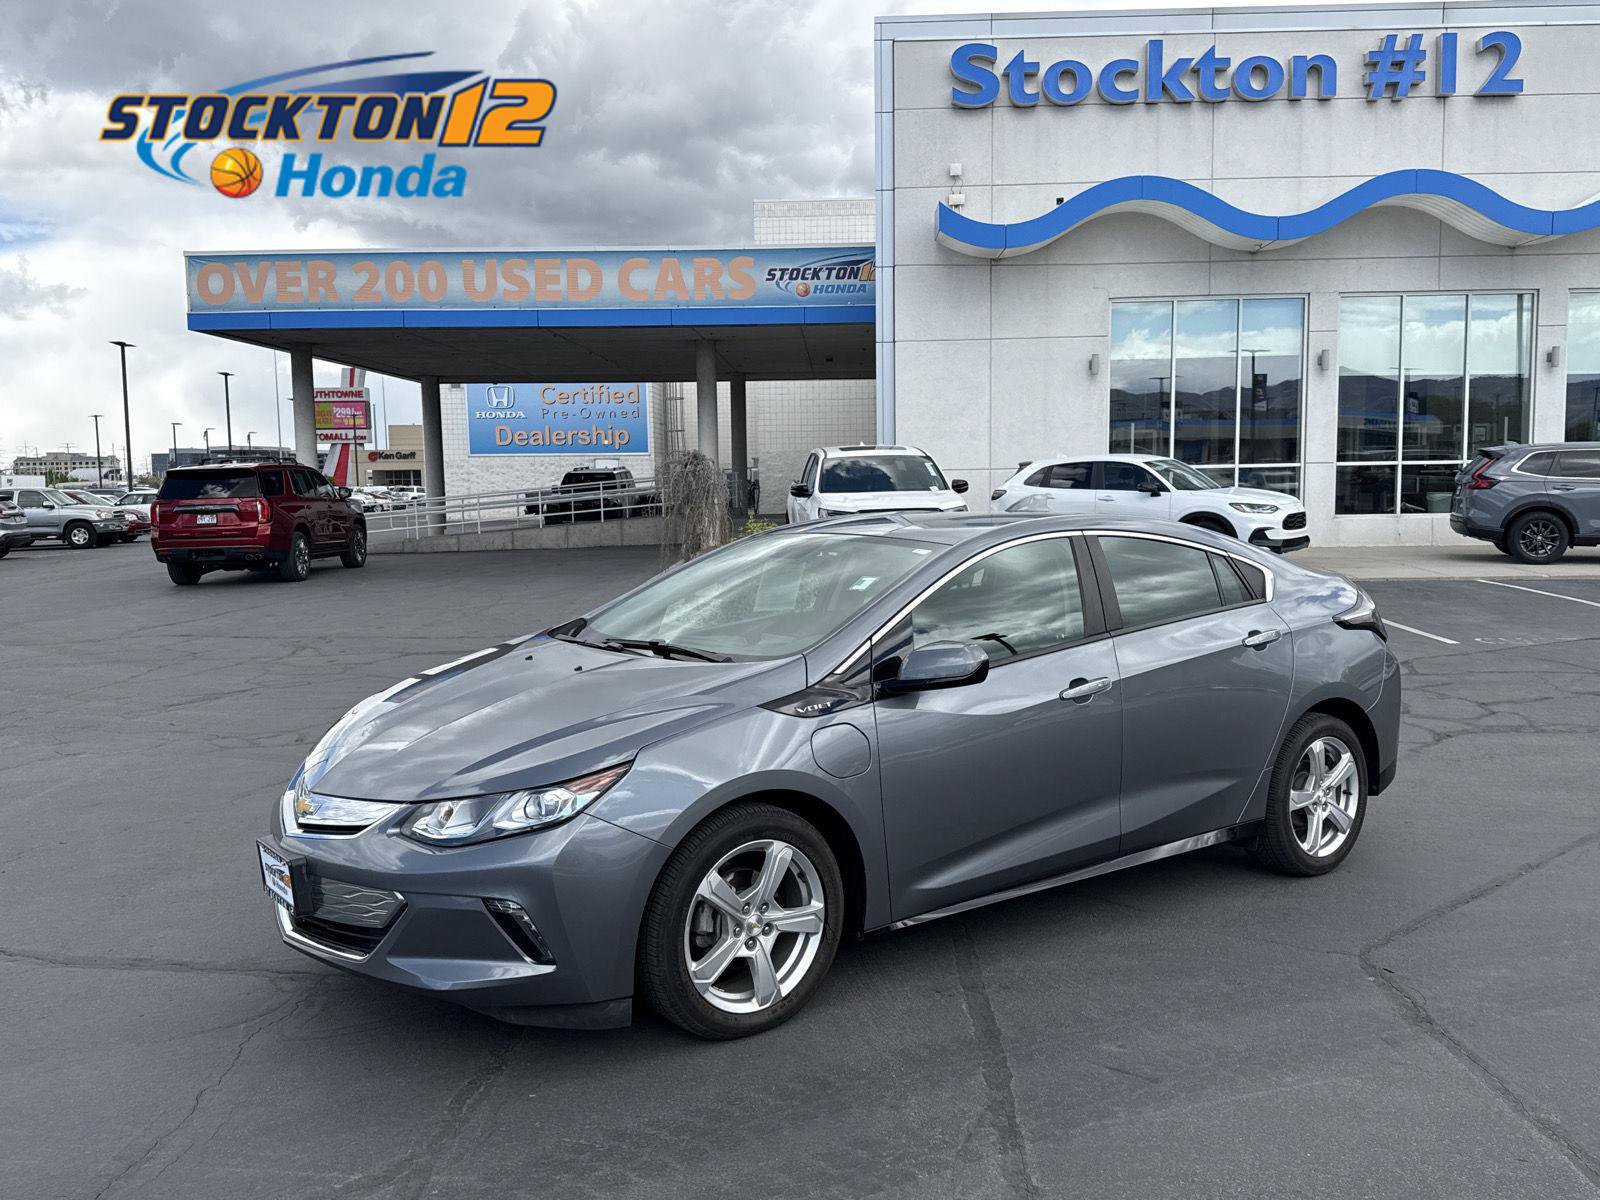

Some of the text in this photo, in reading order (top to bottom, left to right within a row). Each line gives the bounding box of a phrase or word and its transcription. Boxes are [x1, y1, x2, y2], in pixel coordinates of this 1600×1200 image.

[951, 30, 1525, 108] Stockton #12
[196, 256, 757, 305] OVER 200 USED CARS
[765, 266, 861, 282] STOCKTON
[812, 283, 867, 294] HONDA
[540, 384, 640, 404] Certified
[475, 411, 527, 420] HONDA
[541, 407, 640, 420] Pre-Owned
[495, 425, 631, 450] Dealership
[379, 452, 395, 460] Ken
